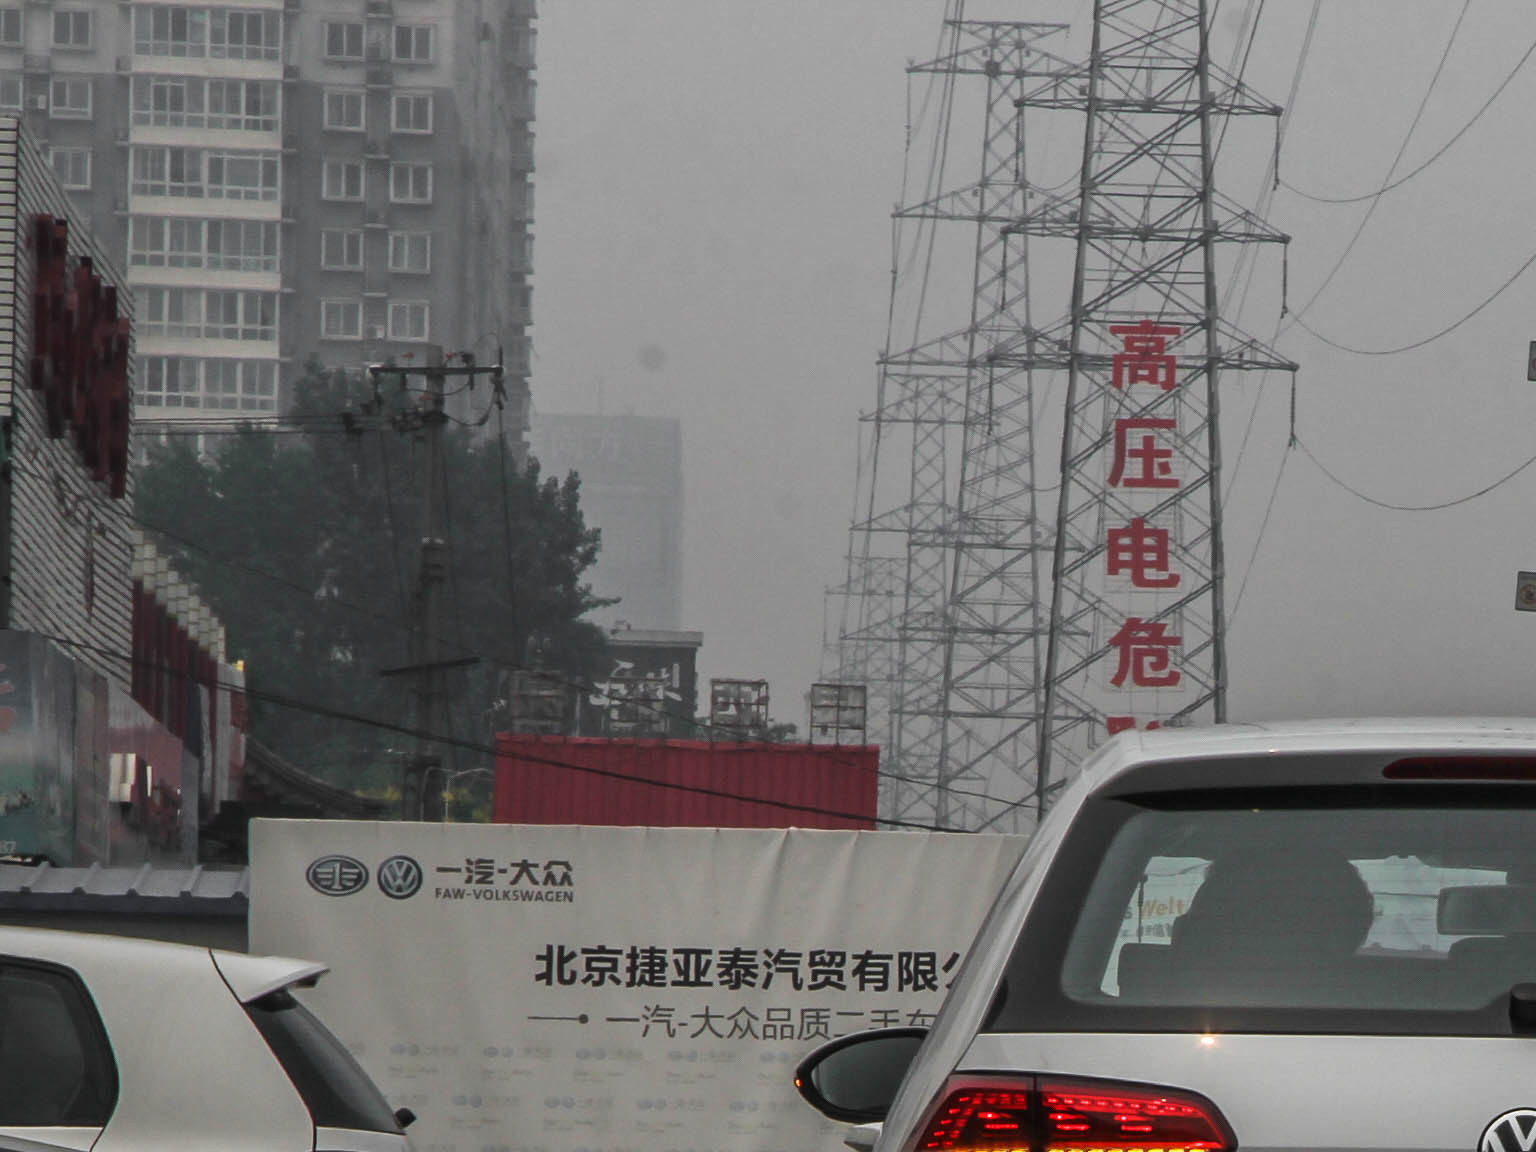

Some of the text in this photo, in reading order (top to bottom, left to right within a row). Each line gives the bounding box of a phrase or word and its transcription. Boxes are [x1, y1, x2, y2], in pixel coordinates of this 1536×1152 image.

[1106, 319, 1182, 735] 高压电危
[436, 858, 574, 887] 一汽-大众
[435, 887, 574, 903] FAW-VOLKSWAGEN
